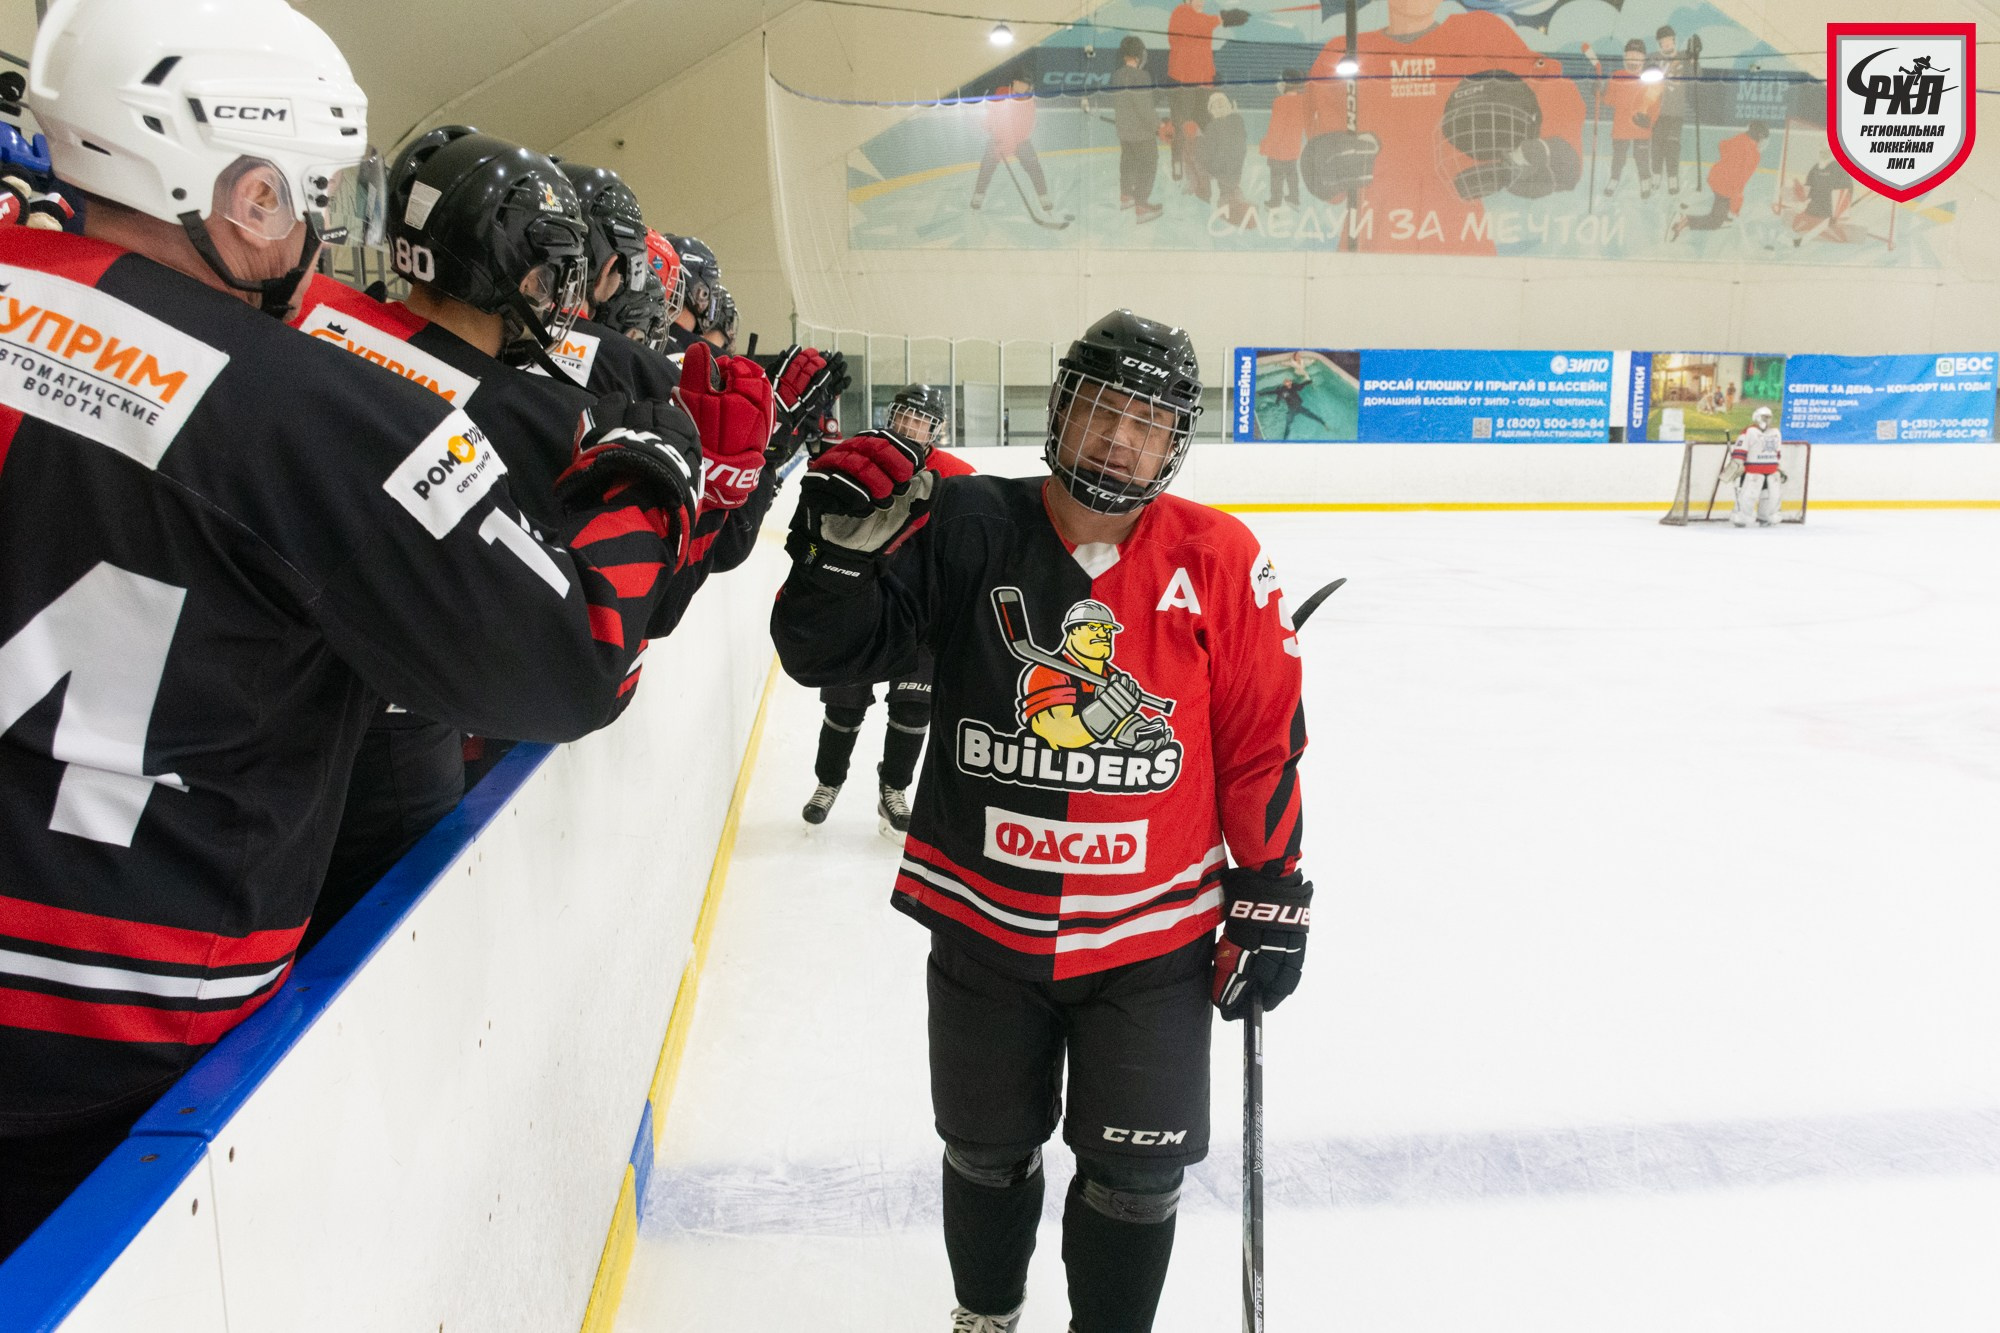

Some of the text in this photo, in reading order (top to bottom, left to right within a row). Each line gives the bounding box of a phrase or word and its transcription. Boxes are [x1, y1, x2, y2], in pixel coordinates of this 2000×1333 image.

[1043, 71, 1112, 85] CCM
[1389, 58, 1436, 82] МИР
[1736, 75, 1789, 101] МИР
[213, 105, 288, 122] CCM
[1206, 201, 1626, 247] СЛЕДУЙ ЗА МЕЧТОЙ
[395, 236, 436, 283] 80
[0, 296, 189, 404] УПРИМ
[1122, 356, 1170, 379] CCM
[1567, 358, 1609, 373] ЗИПО
[1956, 357, 1994, 371] БОС
[0, 347, 160, 427] ВТОМАТИЧСКИЕ
[1239, 356, 1252, 434] БАССЕЙНЫ
[1364, 379, 1608, 392] БРОСАЙ КЛЮШКУ И ПРЫГАЙ В БАССЕЙН!
[1788, 384, 1829, 394] СЕПТИК
[1830, 384, 1844, 394] ЗА
[1845, 384, 1874, 395] ДЕНЬ
[1940, 382, 1956, 392] НА
[23, 376, 103, 420] ВОРОТА
[1363, 396, 1421, 406] ДОМАШНИЙ
[1423, 396, 1466, 406] БАССЕЙН
[1468, 397, 1482, 406] ОТ
[1632, 366, 1646, 428] СЕПТИКИ
[1496, 418, 1504, 428] 8
[1506, 417, 1540, 429] (800)
[456, 472, 478, 493] сеть
[1086, 485, 1128, 504] CCM
[1155, 567, 1202, 615] A
[1102, 1126, 1188, 1146] CCM
